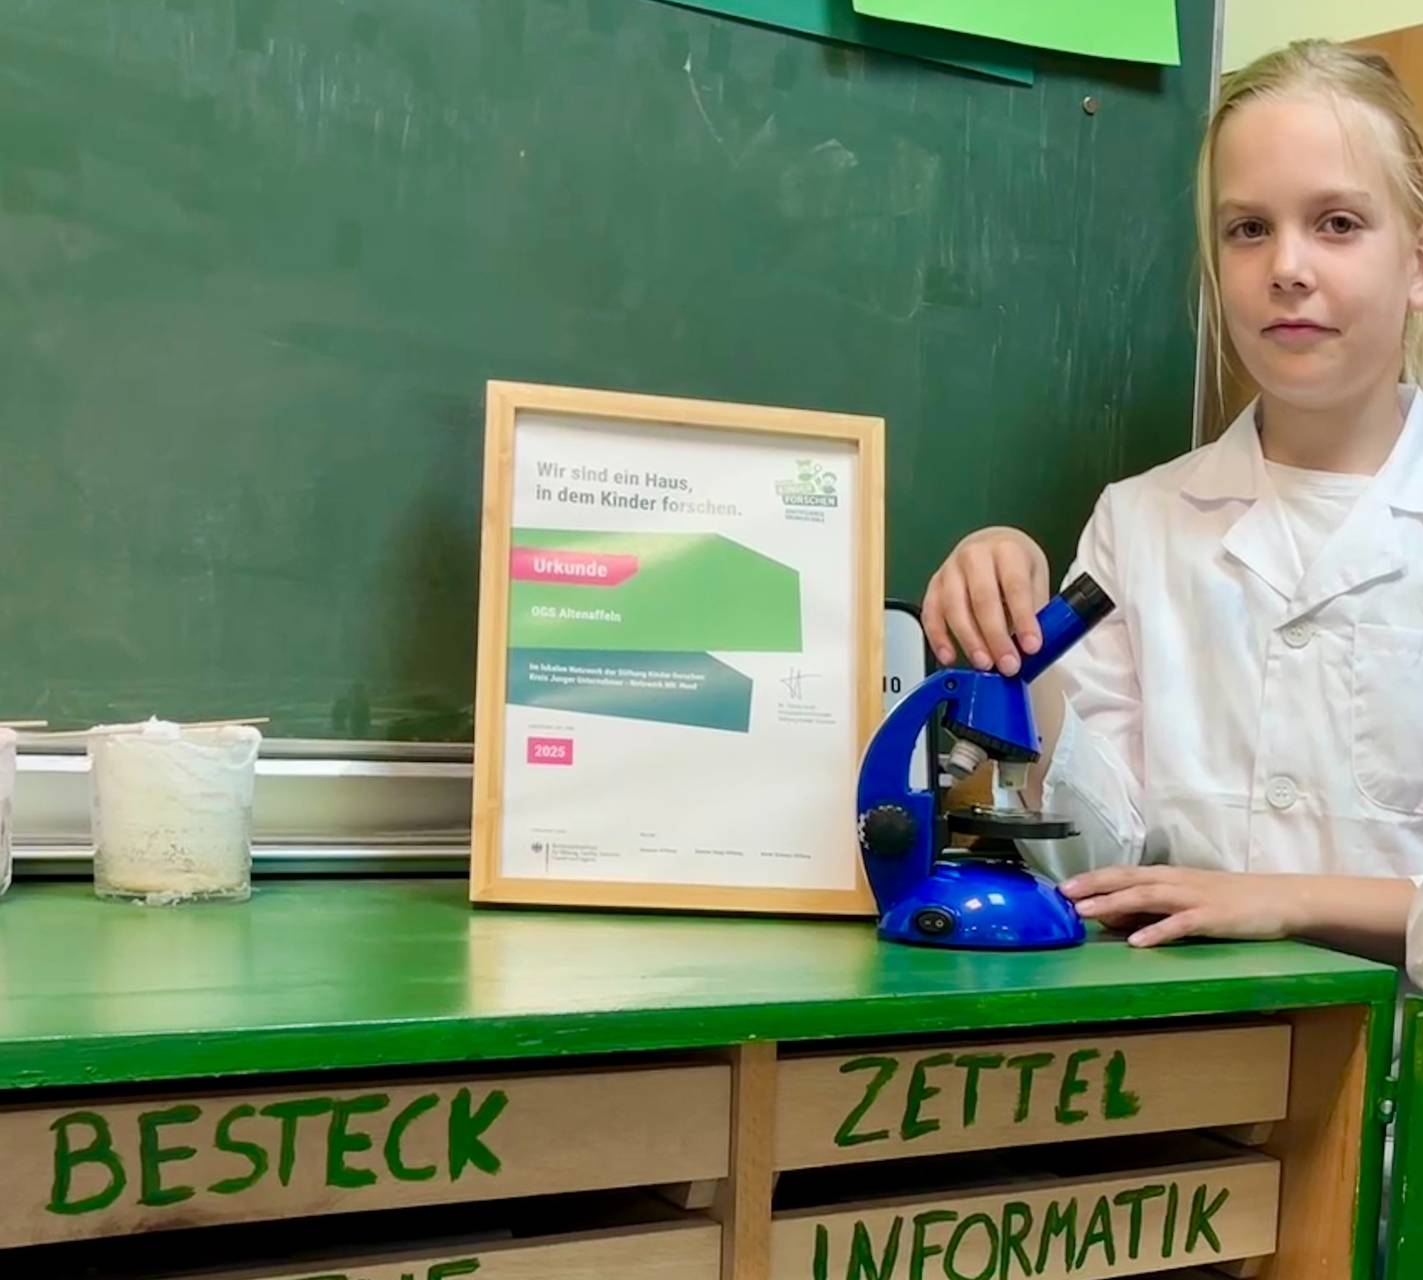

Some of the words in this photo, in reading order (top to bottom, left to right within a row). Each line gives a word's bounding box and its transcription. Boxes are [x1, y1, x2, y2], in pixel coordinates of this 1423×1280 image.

[536, 461, 566, 479] Wir
[571, 465, 608, 483] sind
[613, 469, 640, 487] ein
[645, 472, 693, 494] Haus,
[536, 484, 552, 501] in
[557, 486, 595, 505] dem
[600, 490, 657, 511] Kinder
[662, 496, 742, 517] forschen.
[533, 557, 608, 578] Urkunde
[531, 605, 557, 618] OGS
[558, 606, 622, 623] Altenaffeln
[533, 743, 566, 759] 2025
[833, 1048, 1142, 1148] ZETTEL
[45, 1087, 510, 1216] BESTECK
[812, 1181, 1230, 1280] INFORMATIK
